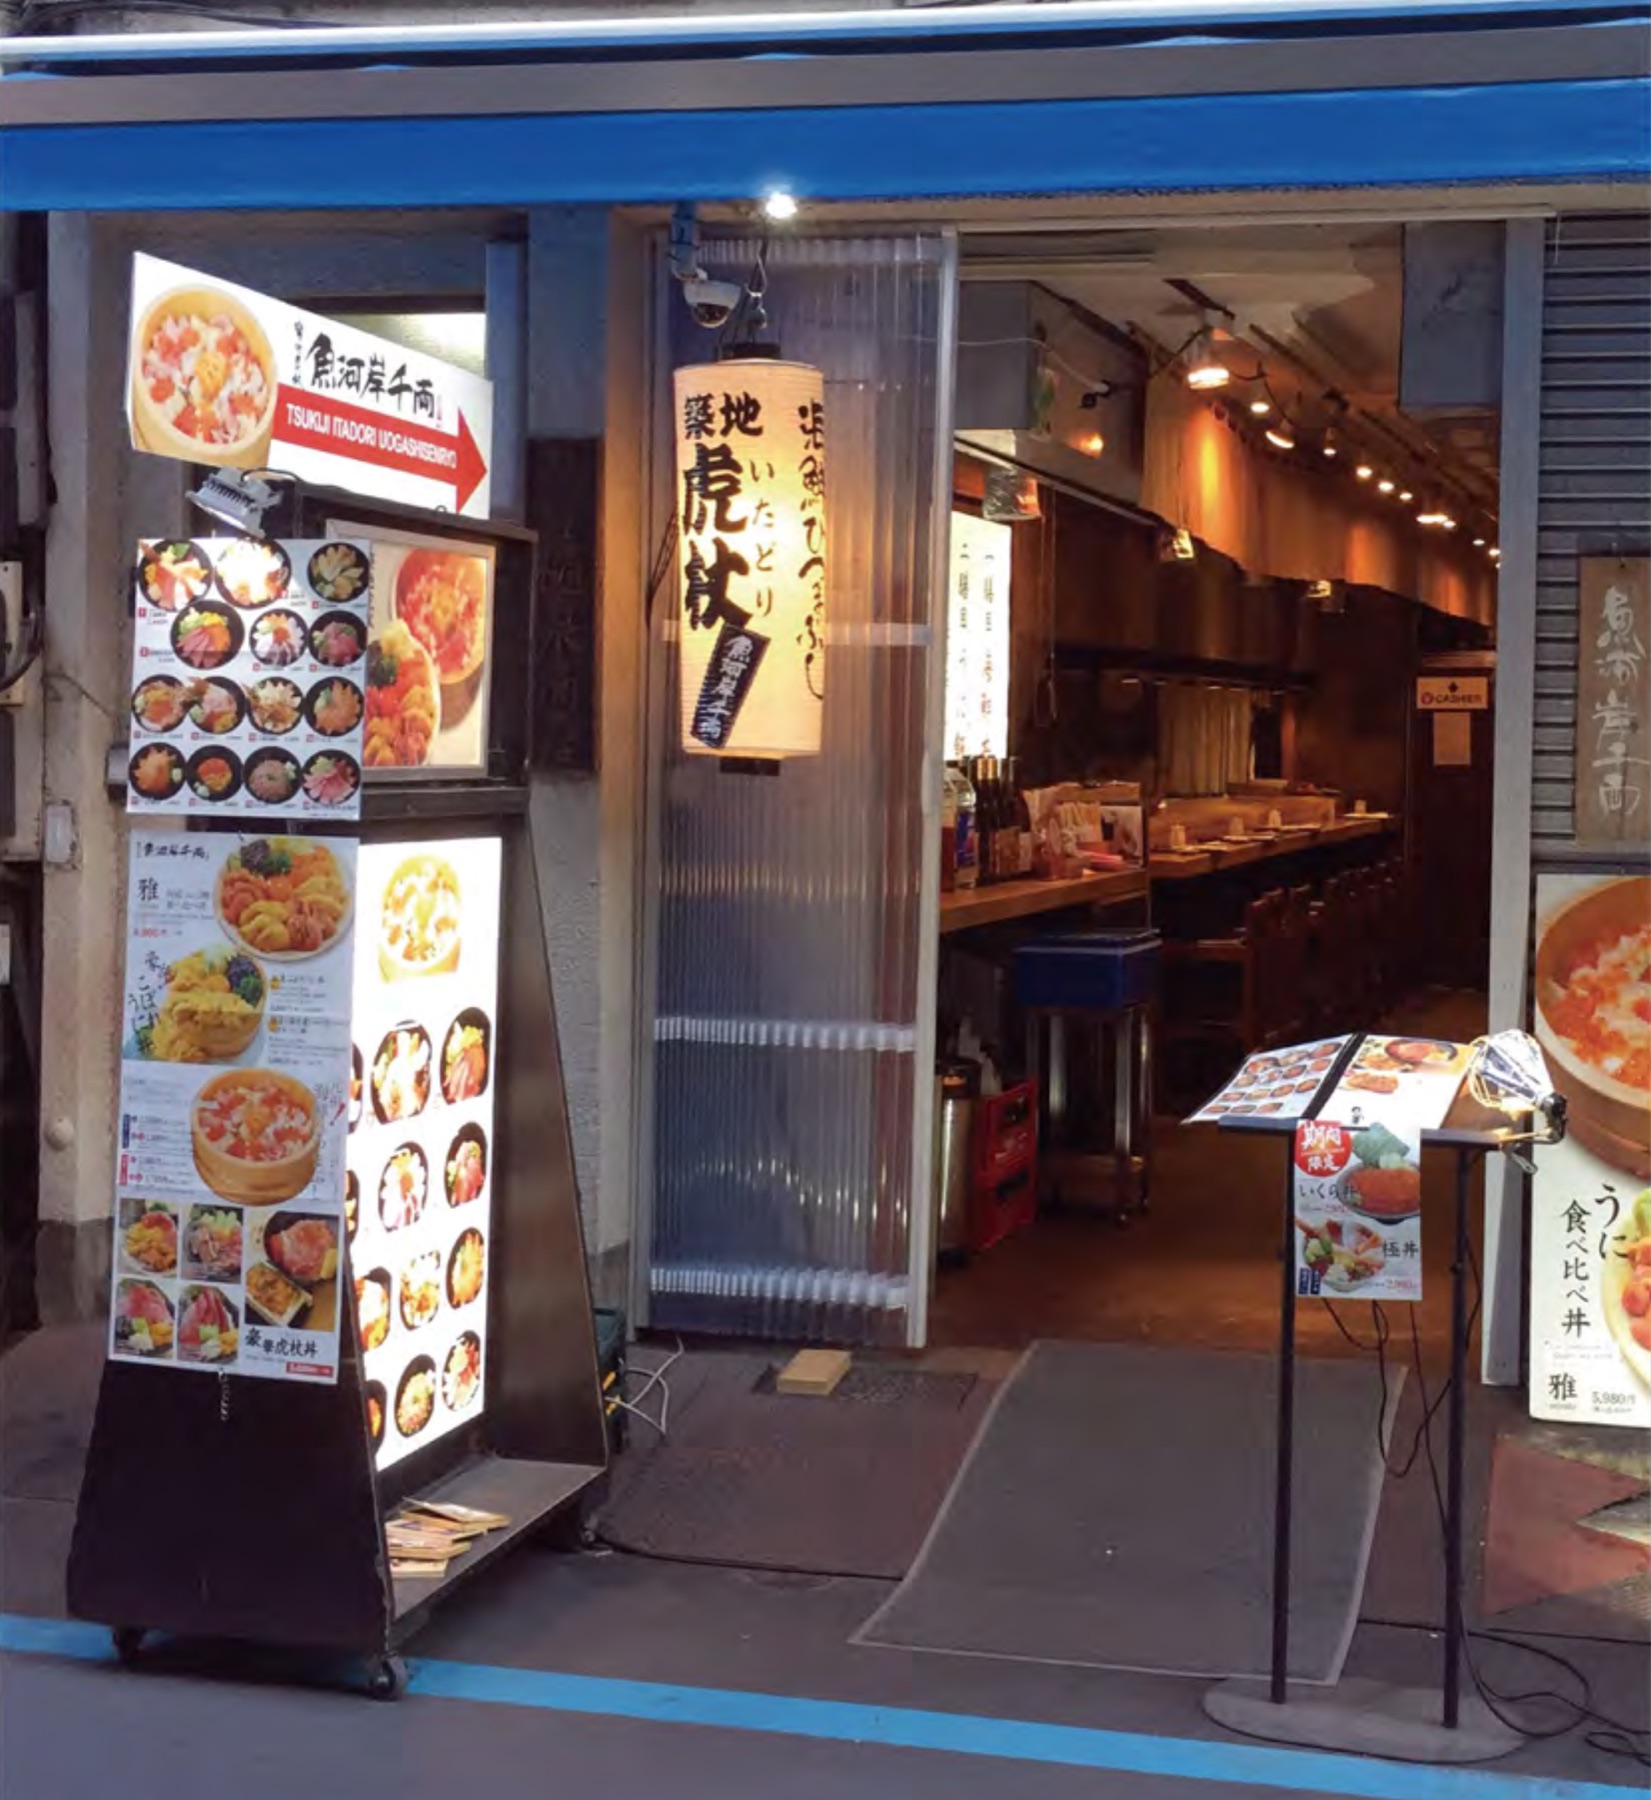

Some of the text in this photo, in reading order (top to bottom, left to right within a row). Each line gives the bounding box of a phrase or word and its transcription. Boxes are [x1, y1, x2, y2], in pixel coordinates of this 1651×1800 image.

[305, 332, 435, 418] 魚河岸千両
[286, 403, 330, 435] TSUKIJI
[333, 416, 376, 446] ITADORI
[685, 391, 763, 441] 築地
[682, 442, 754, 631] 虎杖
[748, 458, 777, 618] いたどり
[137, 877, 159, 901] 雅
[1595, 1183, 1629, 1260] うに
[1548, 1372, 1578, 1401] 雅
